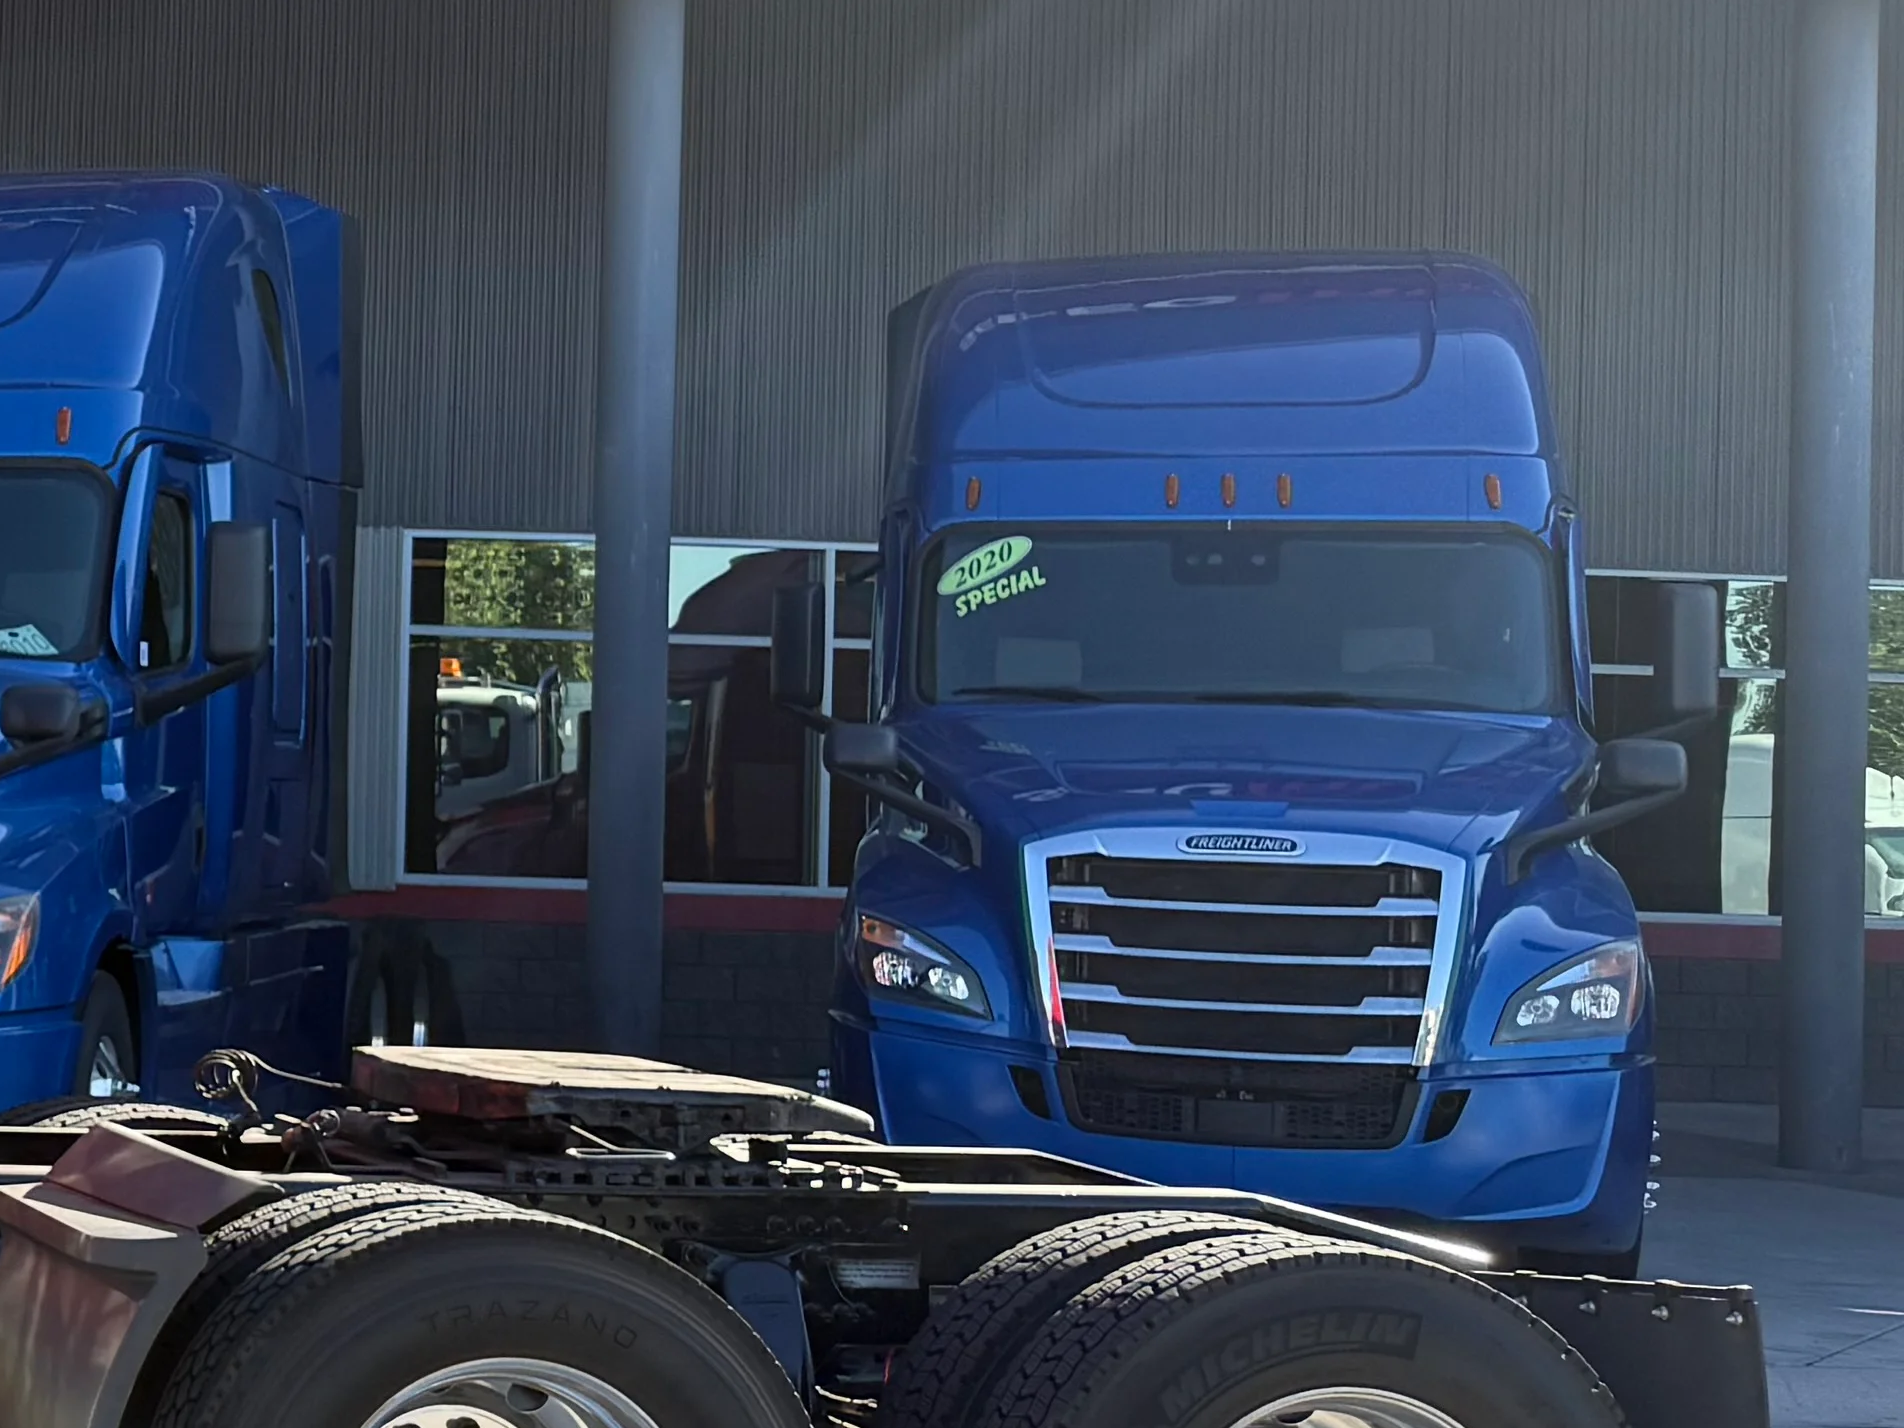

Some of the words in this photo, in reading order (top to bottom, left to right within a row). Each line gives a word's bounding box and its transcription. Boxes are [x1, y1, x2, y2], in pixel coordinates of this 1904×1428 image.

[954, 540, 1012, 589] 2020
[955, 565, 1047, 618] SPECIAL
[1190, 835, 1293, 851] FREIGHTLINER
[421, 1299, 638, 1350] TRAZANO
[1159, 1312, 1418, 1422] MICHELIN
